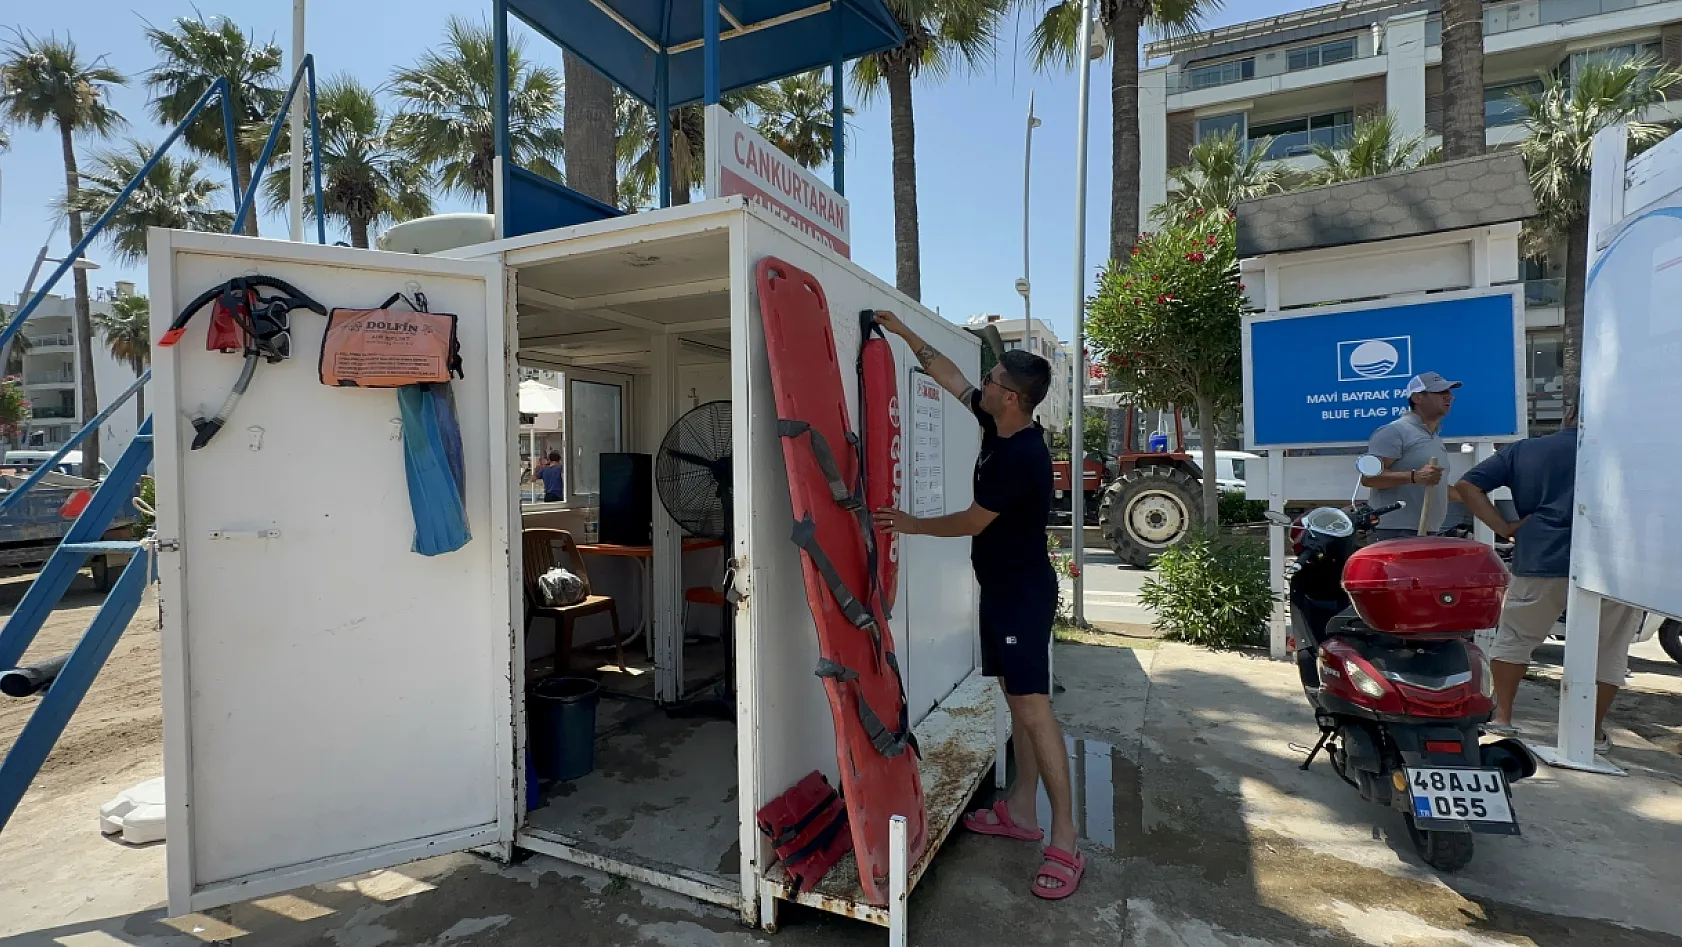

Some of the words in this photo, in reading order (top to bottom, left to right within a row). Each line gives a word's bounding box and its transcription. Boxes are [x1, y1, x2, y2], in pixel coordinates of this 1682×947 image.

[734, 131, 844, 232] CANKURTARAN
[1307, 391, 1338, 404] MAVİ
[1342, 389, 1390, 403] BAYRAK
[1394, 388, 1409, 399] PA
[1322, 409, 1350, 420] BLUE
[1354, 407, 1388, 418] FLAG
[1434, 796, 1488, 818] 055
